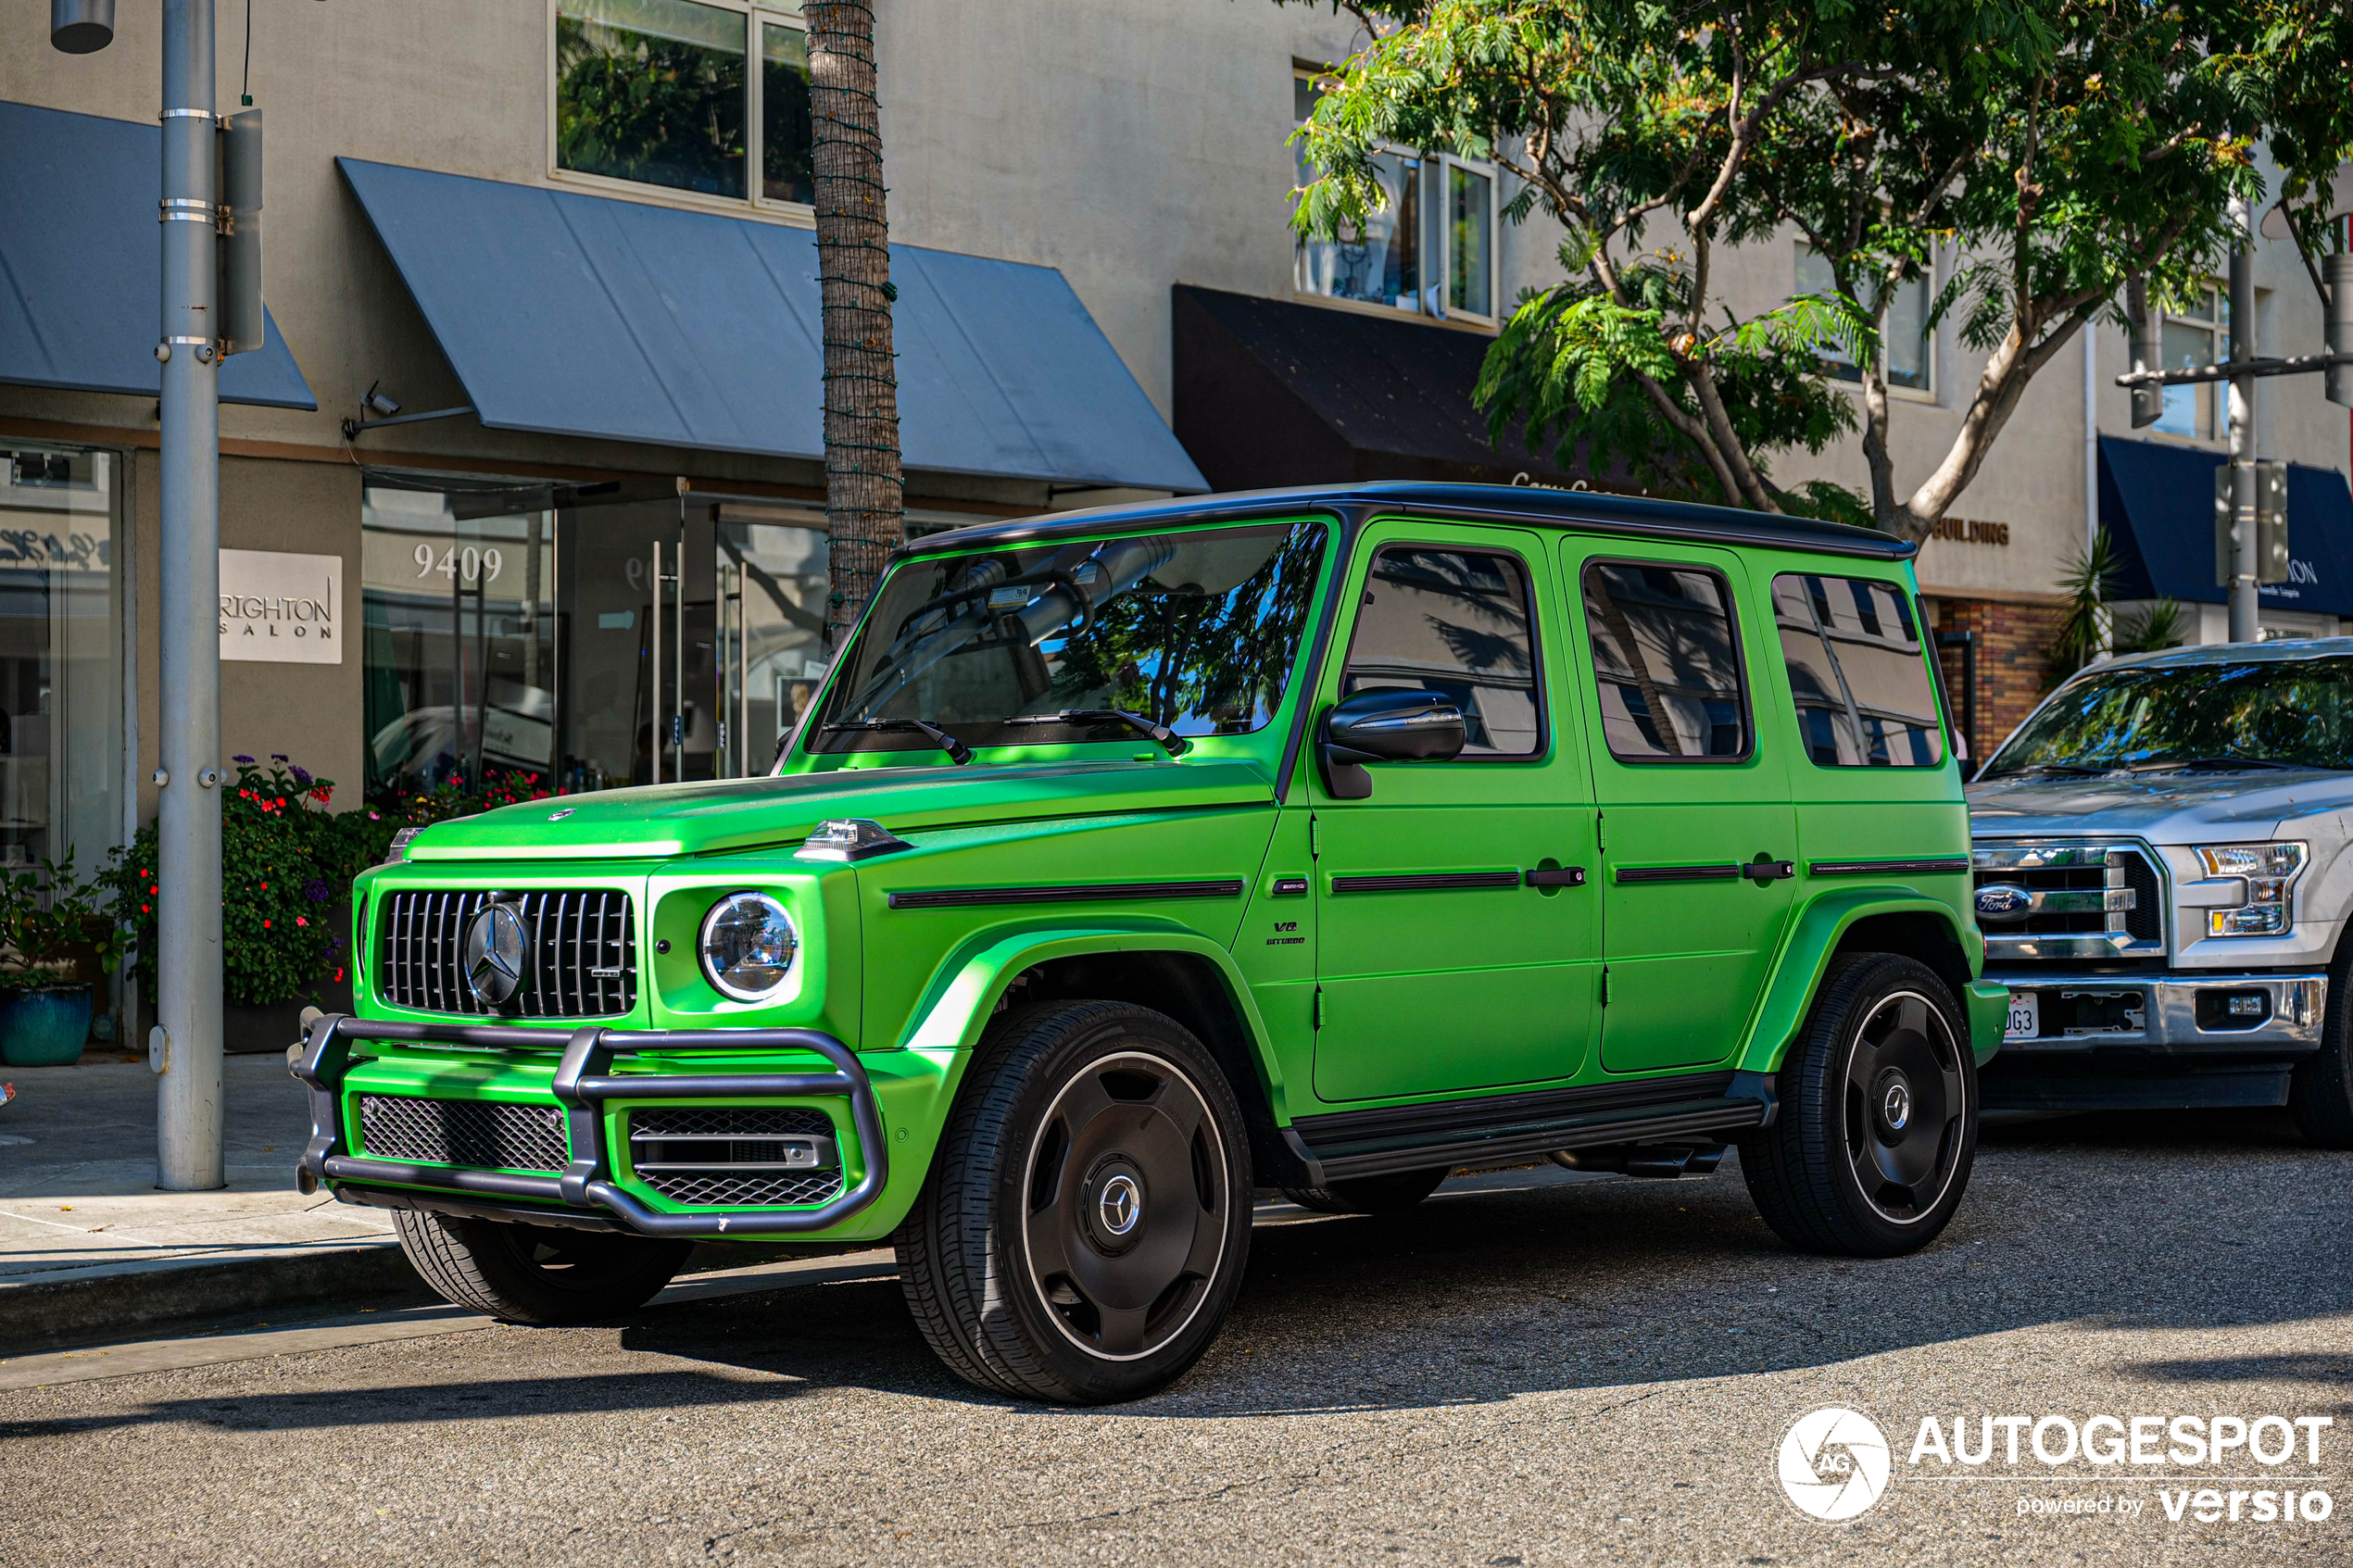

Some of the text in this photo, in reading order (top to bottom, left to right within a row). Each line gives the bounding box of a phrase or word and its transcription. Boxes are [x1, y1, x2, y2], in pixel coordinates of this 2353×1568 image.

[413, 544, 502, 583] 9409
[219, 621, 332, 639] SALON
[1978, 894, 2013, 910] Ford
[1274, 922, 1298, 933] V8
